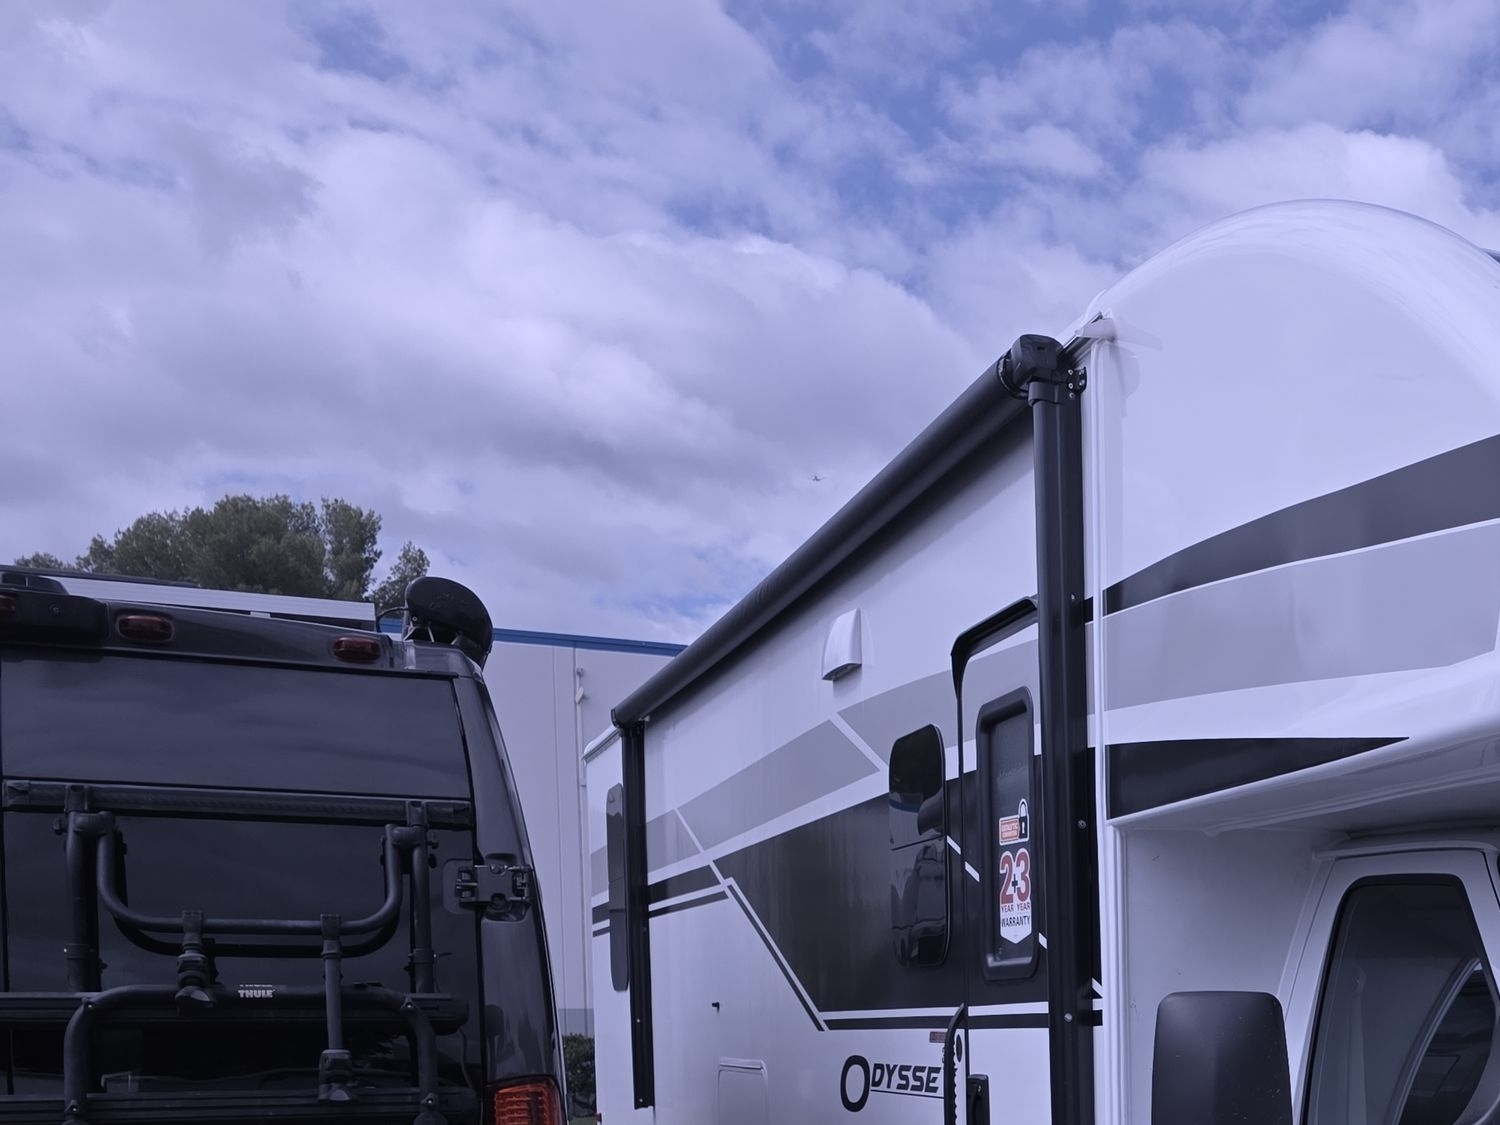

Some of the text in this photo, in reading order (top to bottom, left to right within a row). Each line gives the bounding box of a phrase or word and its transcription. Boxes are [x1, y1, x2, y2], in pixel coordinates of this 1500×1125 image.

[1001, 901, 1030, 913] YEAR YEAR
[1001, 915, 1030, 928] WARRANTY
[238, 989, 274, 998] THULE
[840, 1054, 957, 1112] ODYSSE
